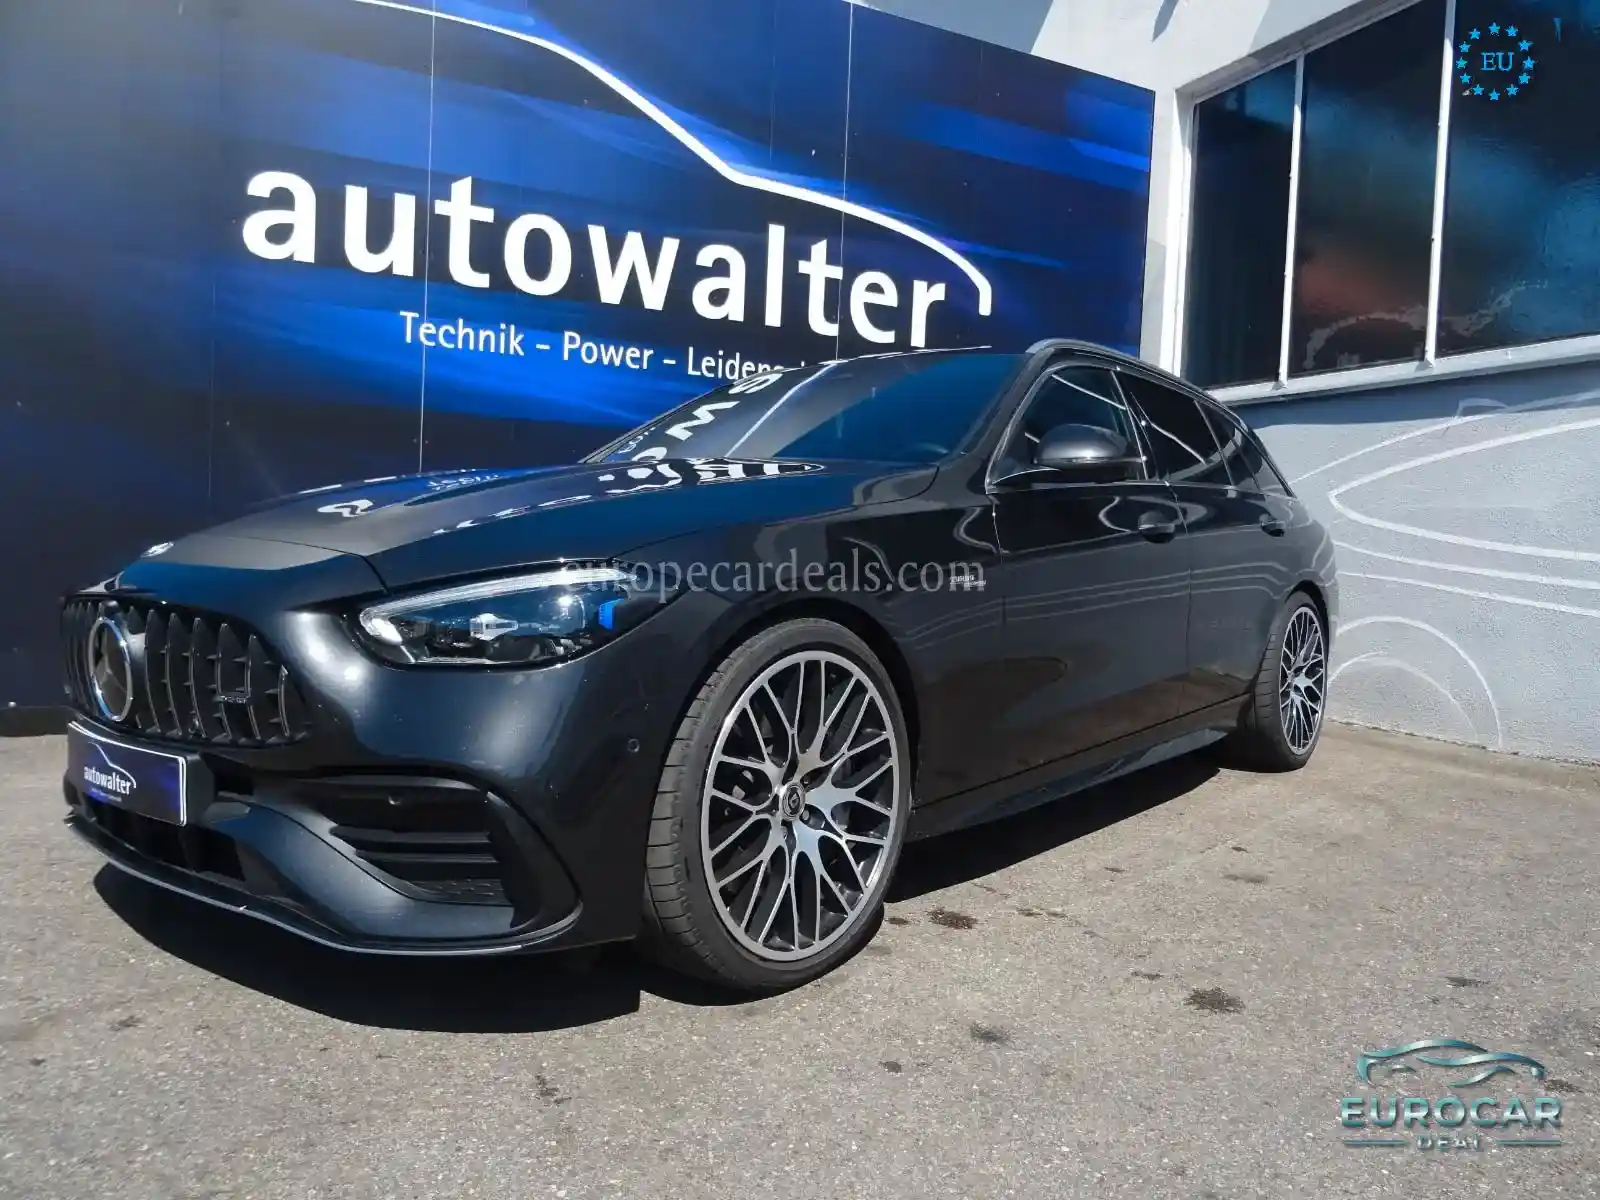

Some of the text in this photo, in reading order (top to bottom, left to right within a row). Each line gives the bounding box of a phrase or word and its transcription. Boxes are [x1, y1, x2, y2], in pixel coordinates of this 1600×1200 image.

[242, 170, 946, 348] autowalter
[400, 310, 525, 356] Technik
[562, 330, 654, 370] Power
[83, 766, 131, 796] autowalter
